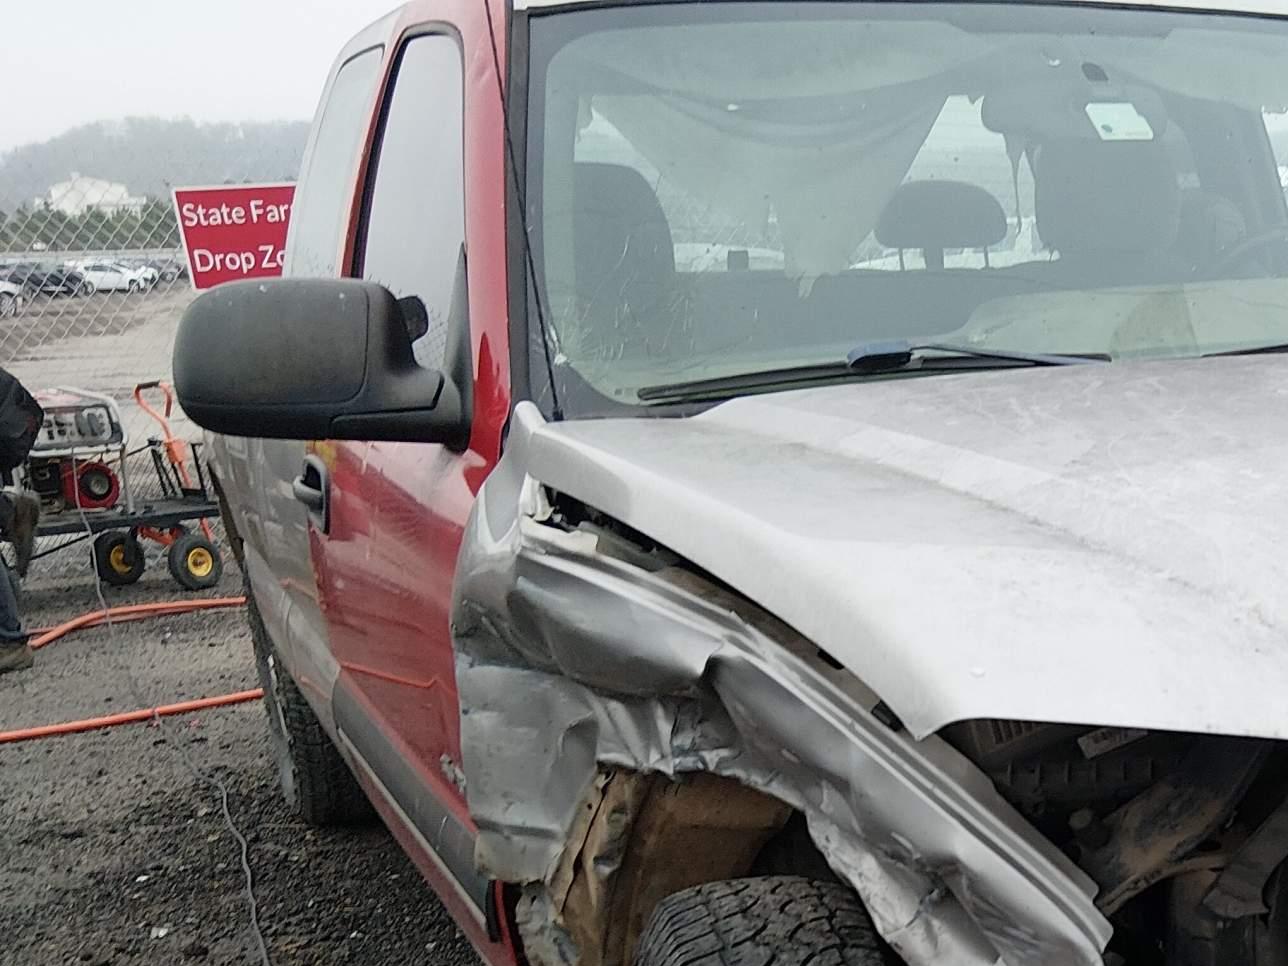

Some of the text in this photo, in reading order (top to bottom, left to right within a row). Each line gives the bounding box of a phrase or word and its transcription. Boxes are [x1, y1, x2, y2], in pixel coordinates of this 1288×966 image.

[182, 199, 293, 227] State Far
[193, 248, 256, 274] Drop
